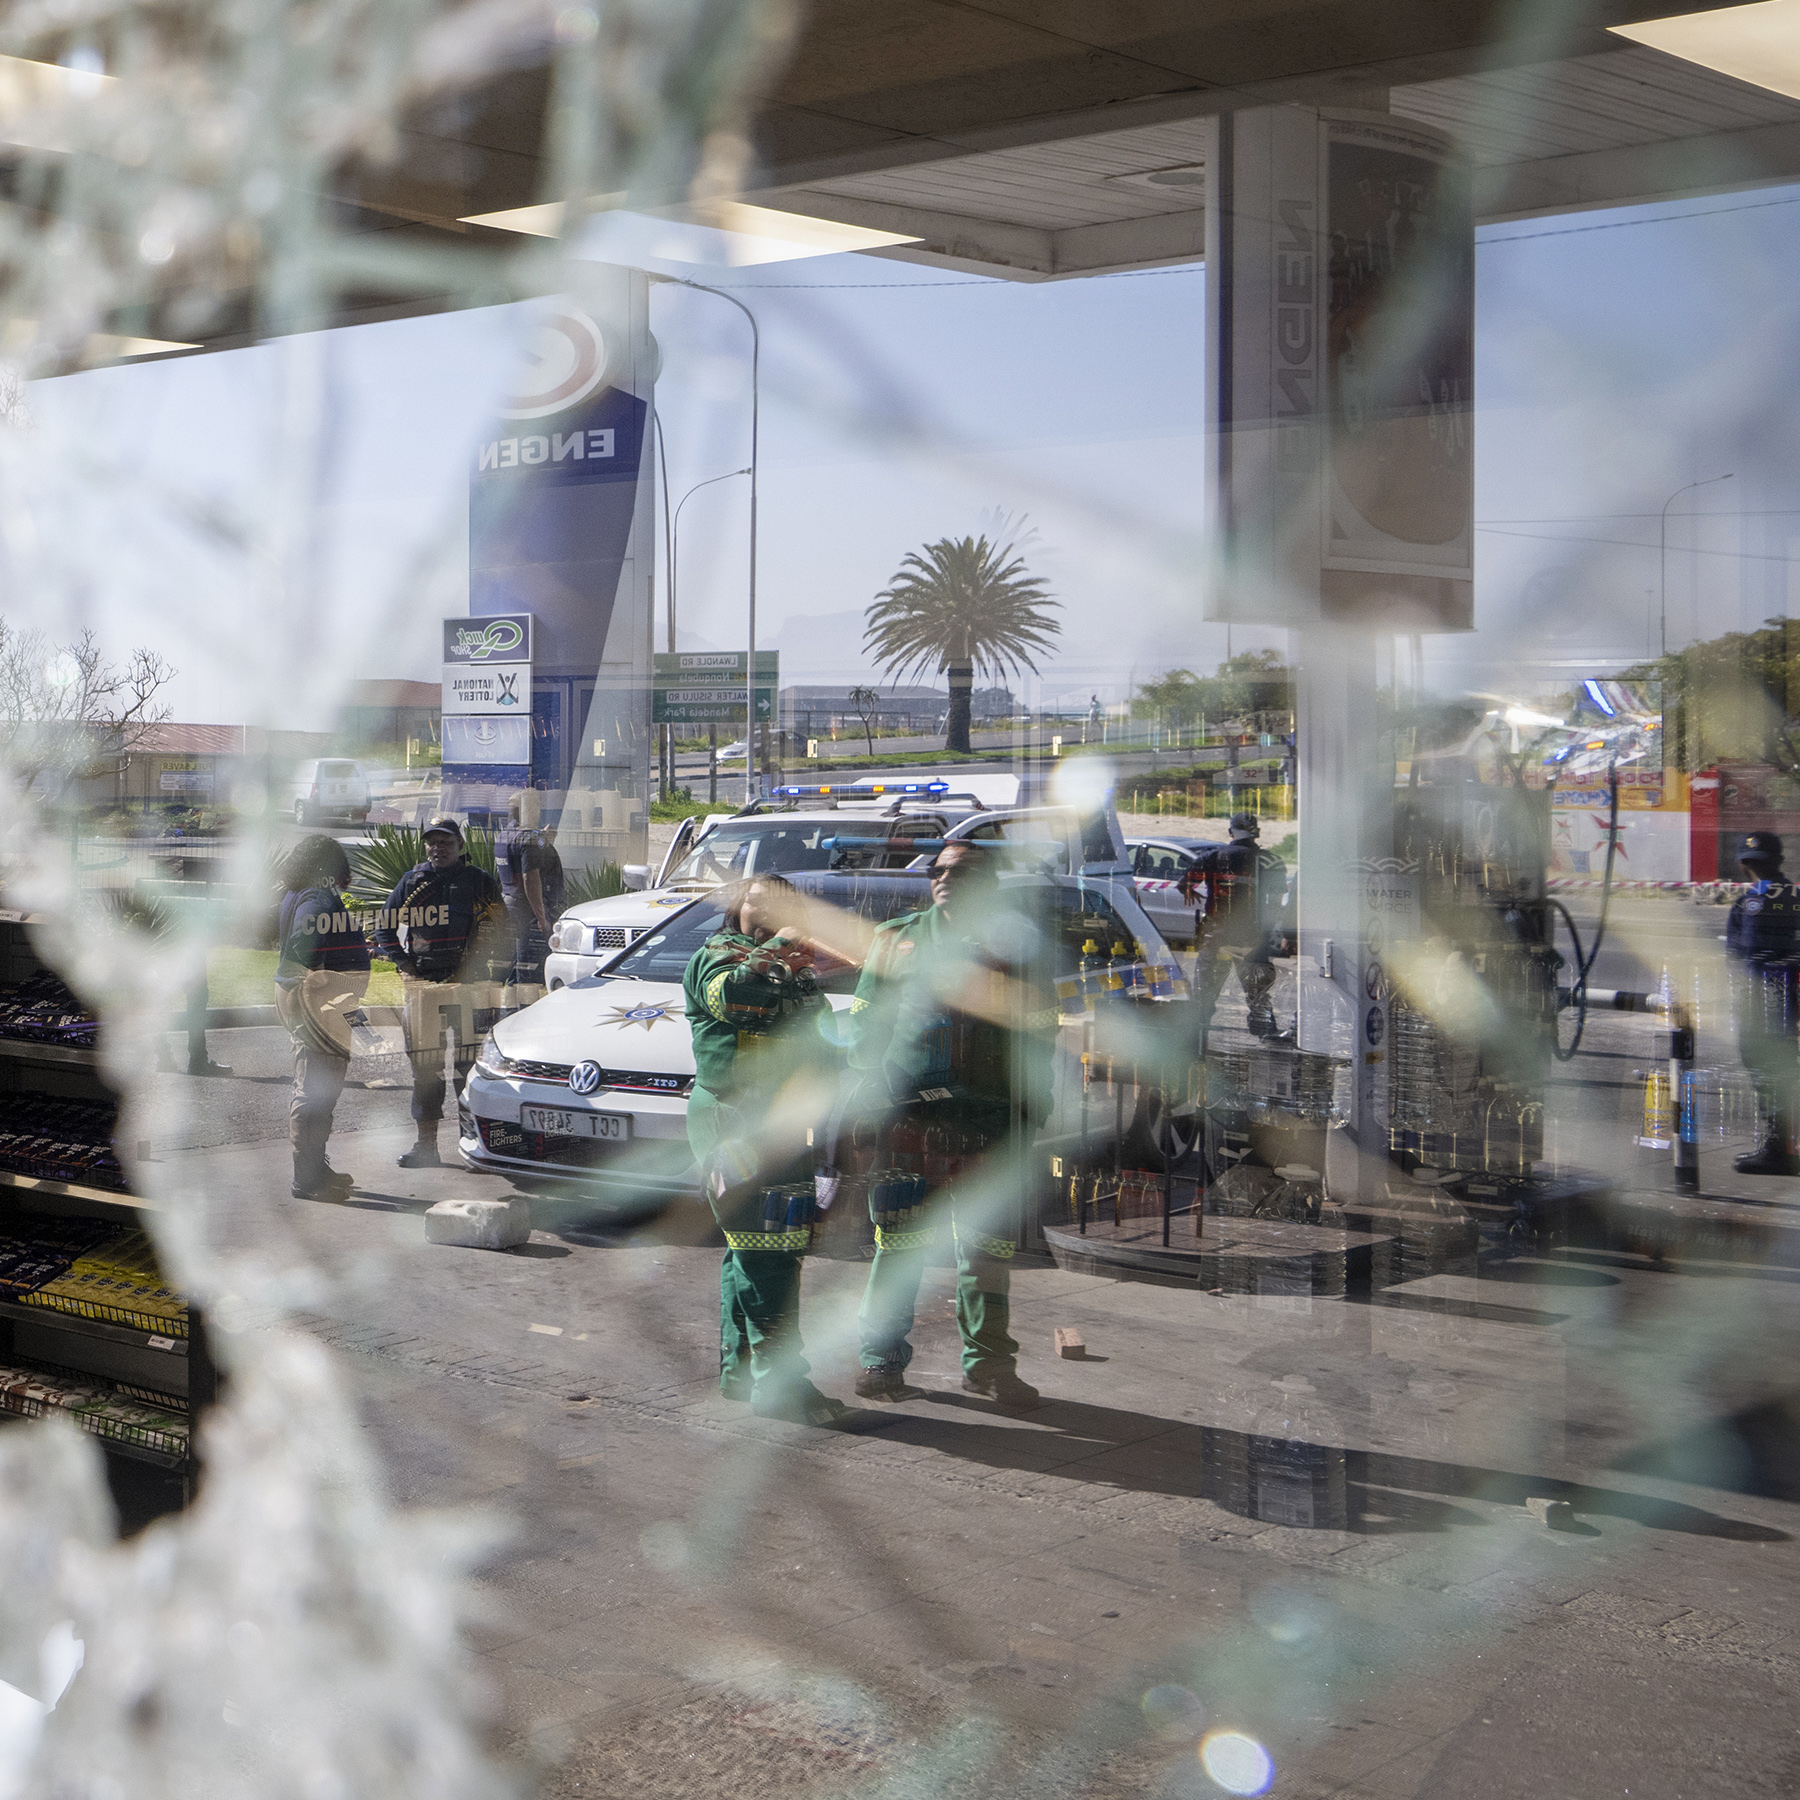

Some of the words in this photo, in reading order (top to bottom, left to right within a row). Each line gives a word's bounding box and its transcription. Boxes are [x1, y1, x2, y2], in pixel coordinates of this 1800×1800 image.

[1366, 889, 1412, 899] WATER
[303, 904, 450, 936] CONVENIENCE
[489, 1128, 508, 1139] FIRE-
[489, 1134, 523, 1147] LIGHTERS
